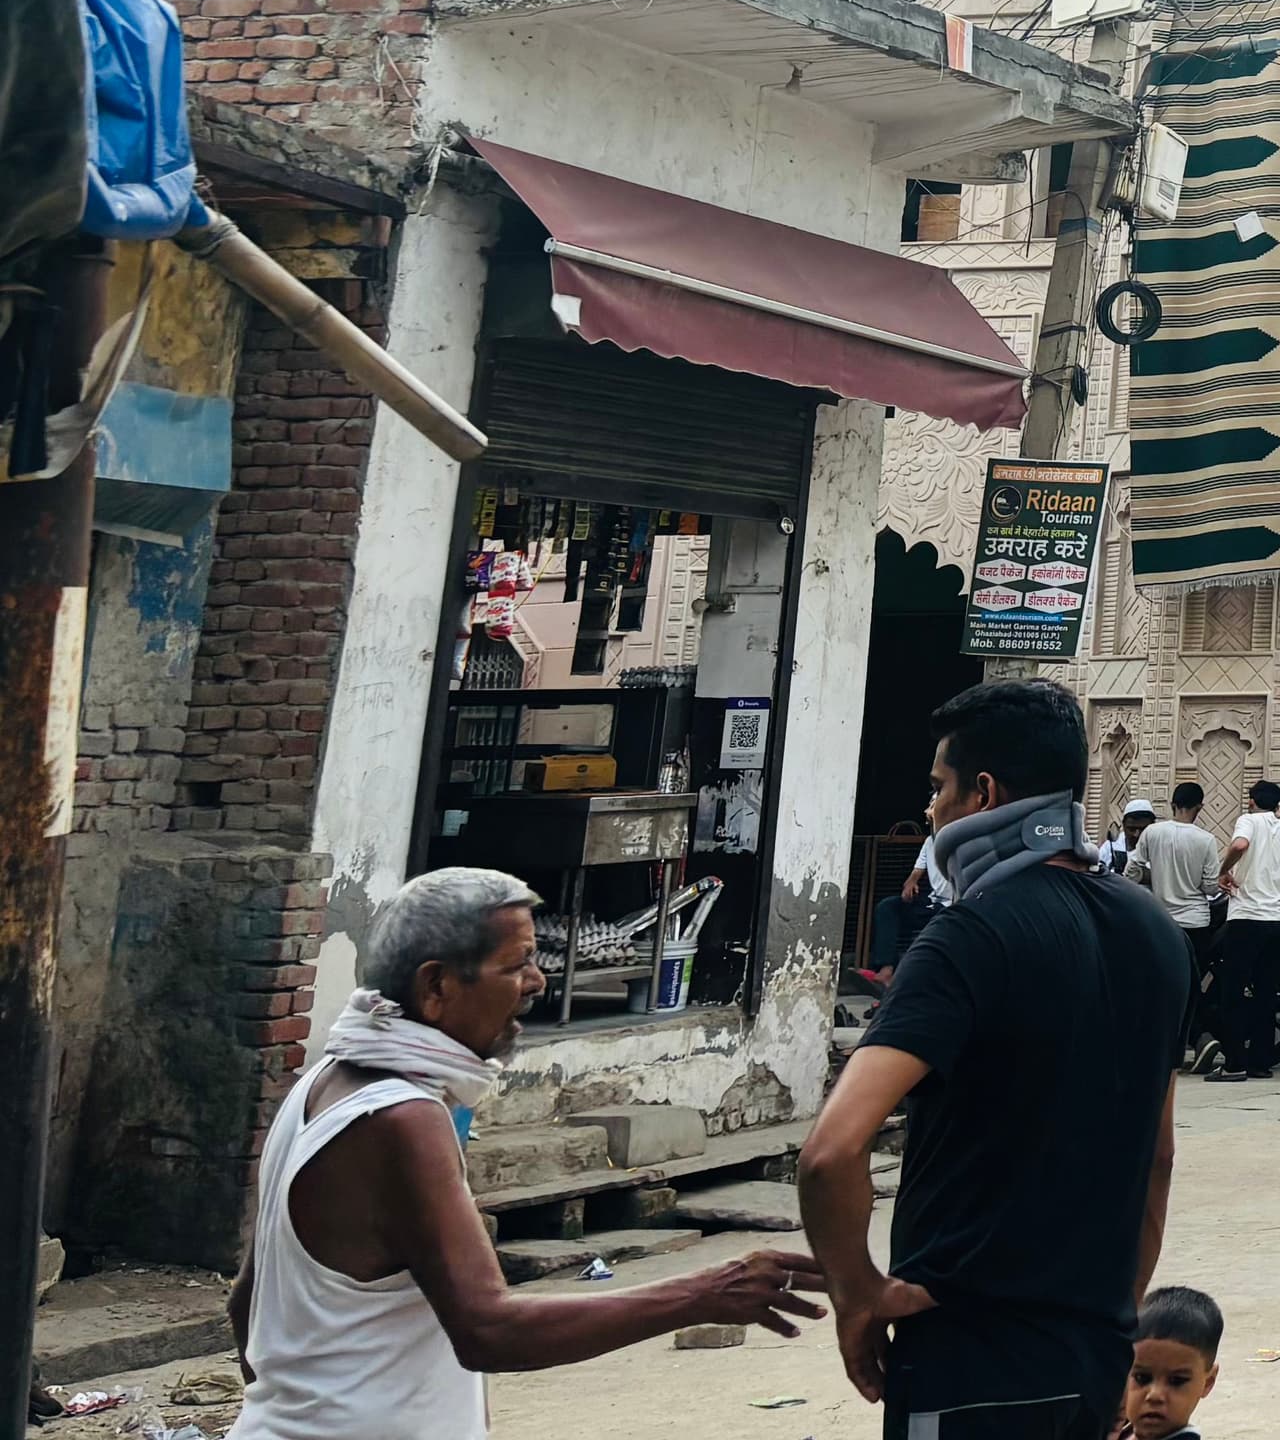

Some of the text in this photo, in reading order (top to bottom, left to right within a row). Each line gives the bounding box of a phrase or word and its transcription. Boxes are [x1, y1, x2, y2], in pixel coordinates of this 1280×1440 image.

[1026, 489, 1096, 512] Ridaan
[1040, 510, 1093, 525] Tourism
[984, 531, 1088, 560] उमराह करें
[970, 621, 1069, 632] Main Market Garima Garden
[970, 638, 1063, 650] Mob. 8860918552
